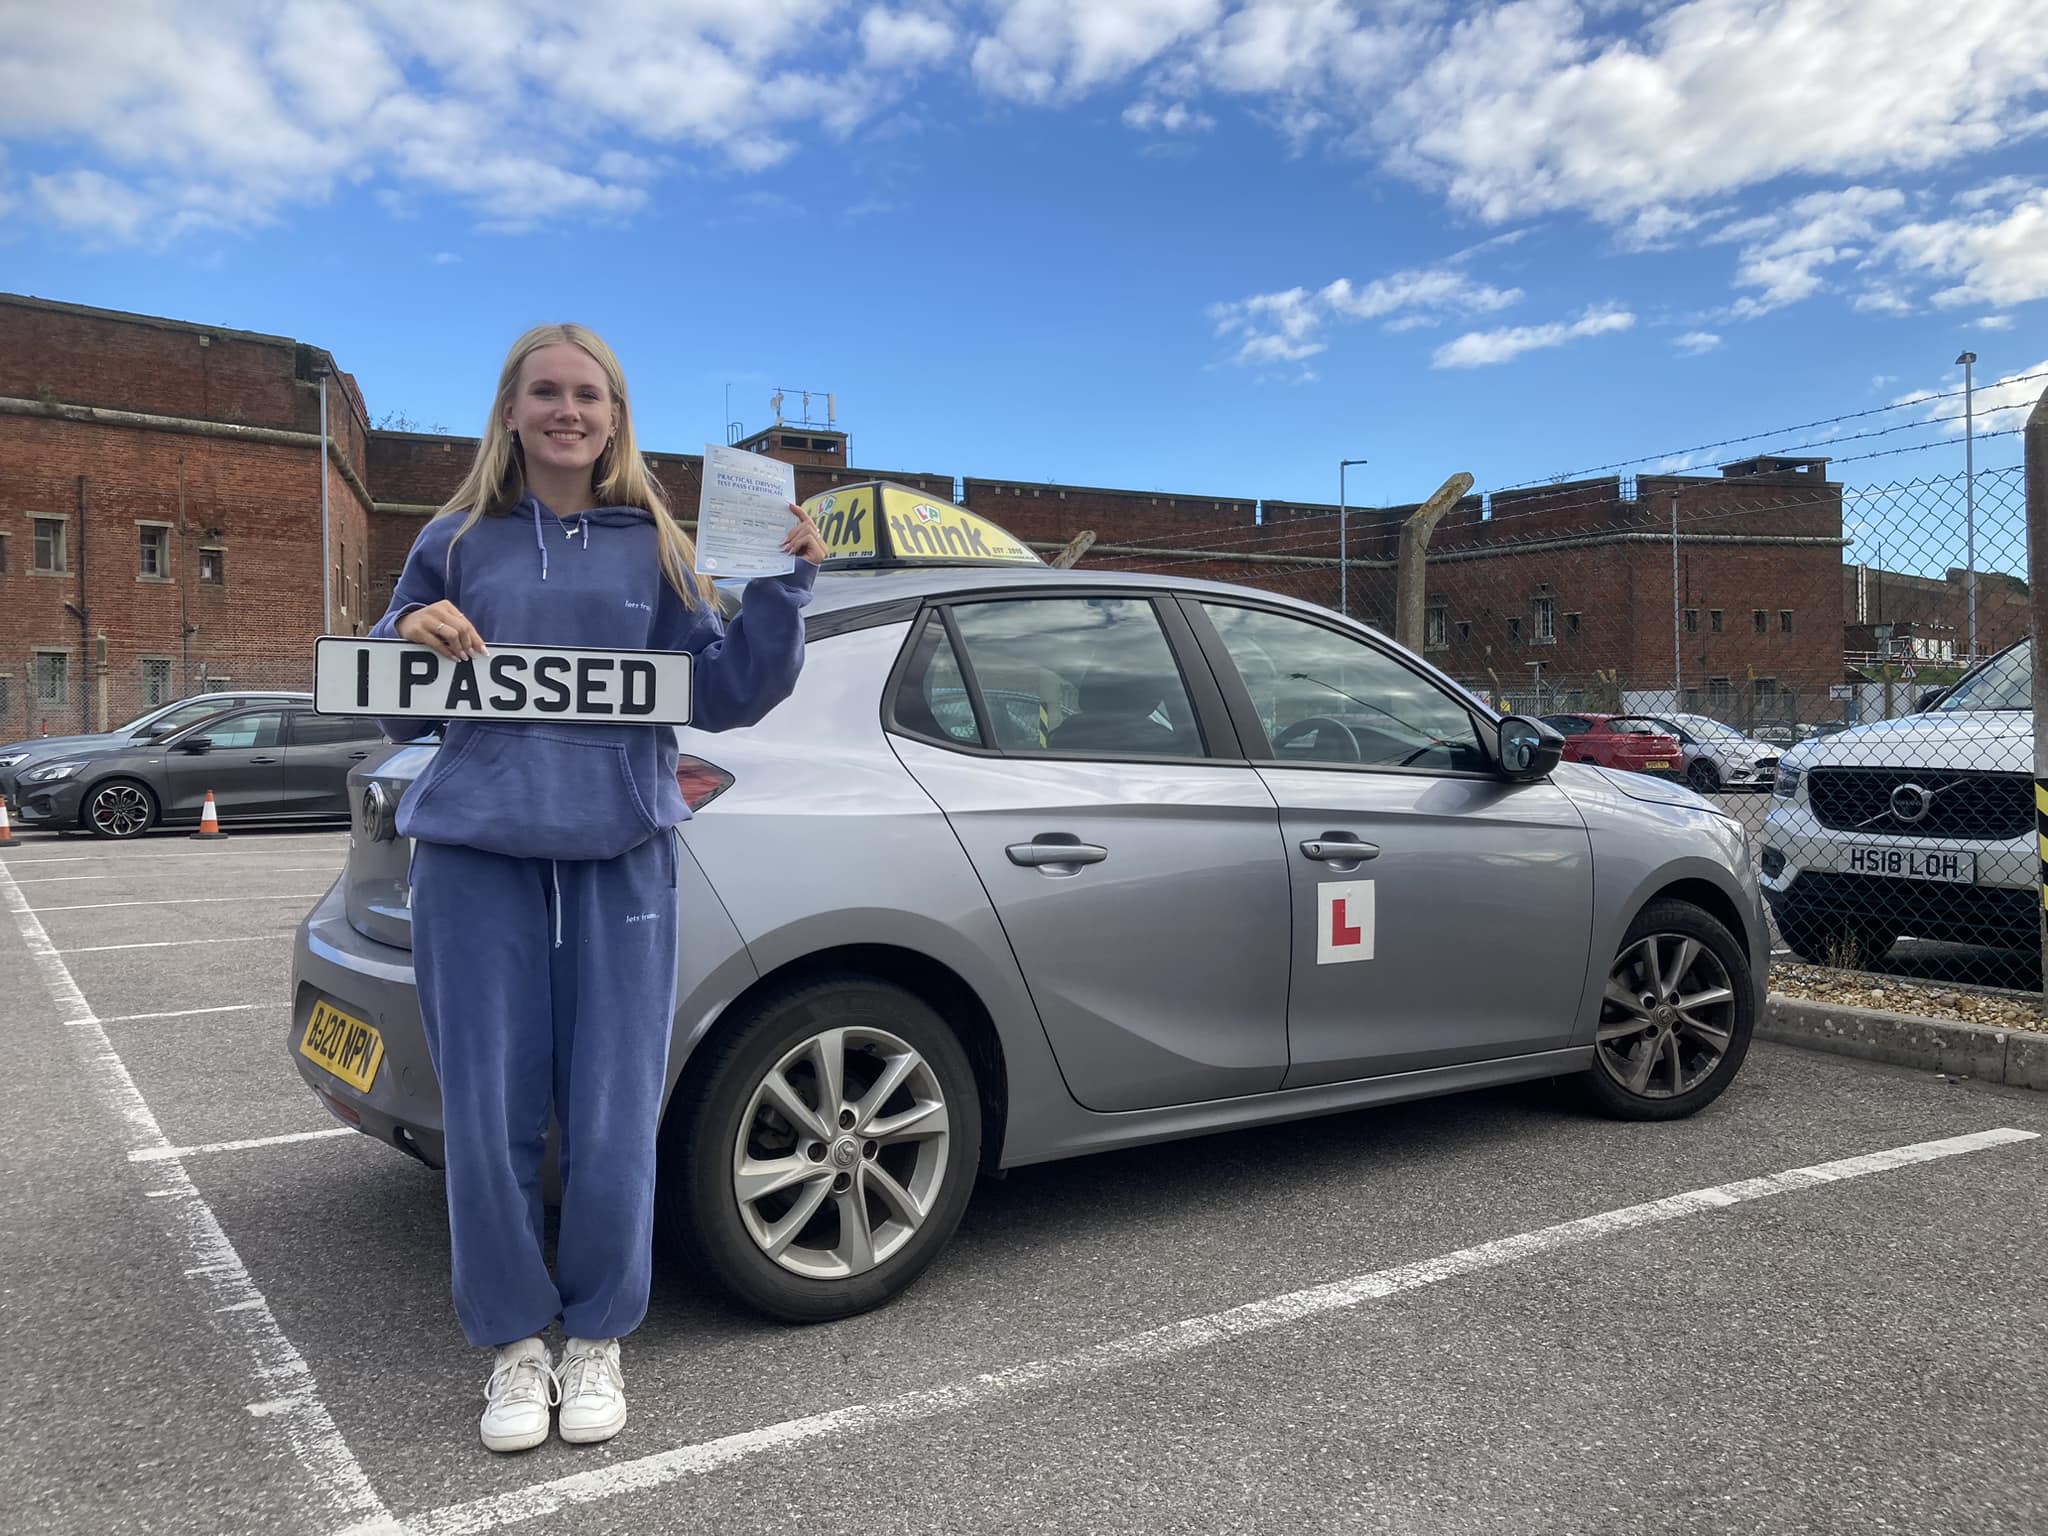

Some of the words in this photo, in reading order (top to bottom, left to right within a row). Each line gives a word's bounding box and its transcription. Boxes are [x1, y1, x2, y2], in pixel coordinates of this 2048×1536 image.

[717, 473, 753, 485] PRACTICAL
[754, 479, 784, 491] DRIVING
[717, 480, 732, 489] TEST
[732, 481, 748, 490] PASS
[748, 484, 784, 497] CERTIFICATE
[817, 497, 867, 546] ink
[891, 513, 991, 557] think
[356, 648, 370, 708] I
[399, 650, 658, 715] PASSED
[1851, 848, 1902, 873] HS18
[1909, 853, 1957, 878] LOH
[1332, 899, 1361, 946] L
[307, 1006, 346, 1060] BJ20
[338, 1023, 380, 1079] NPN
